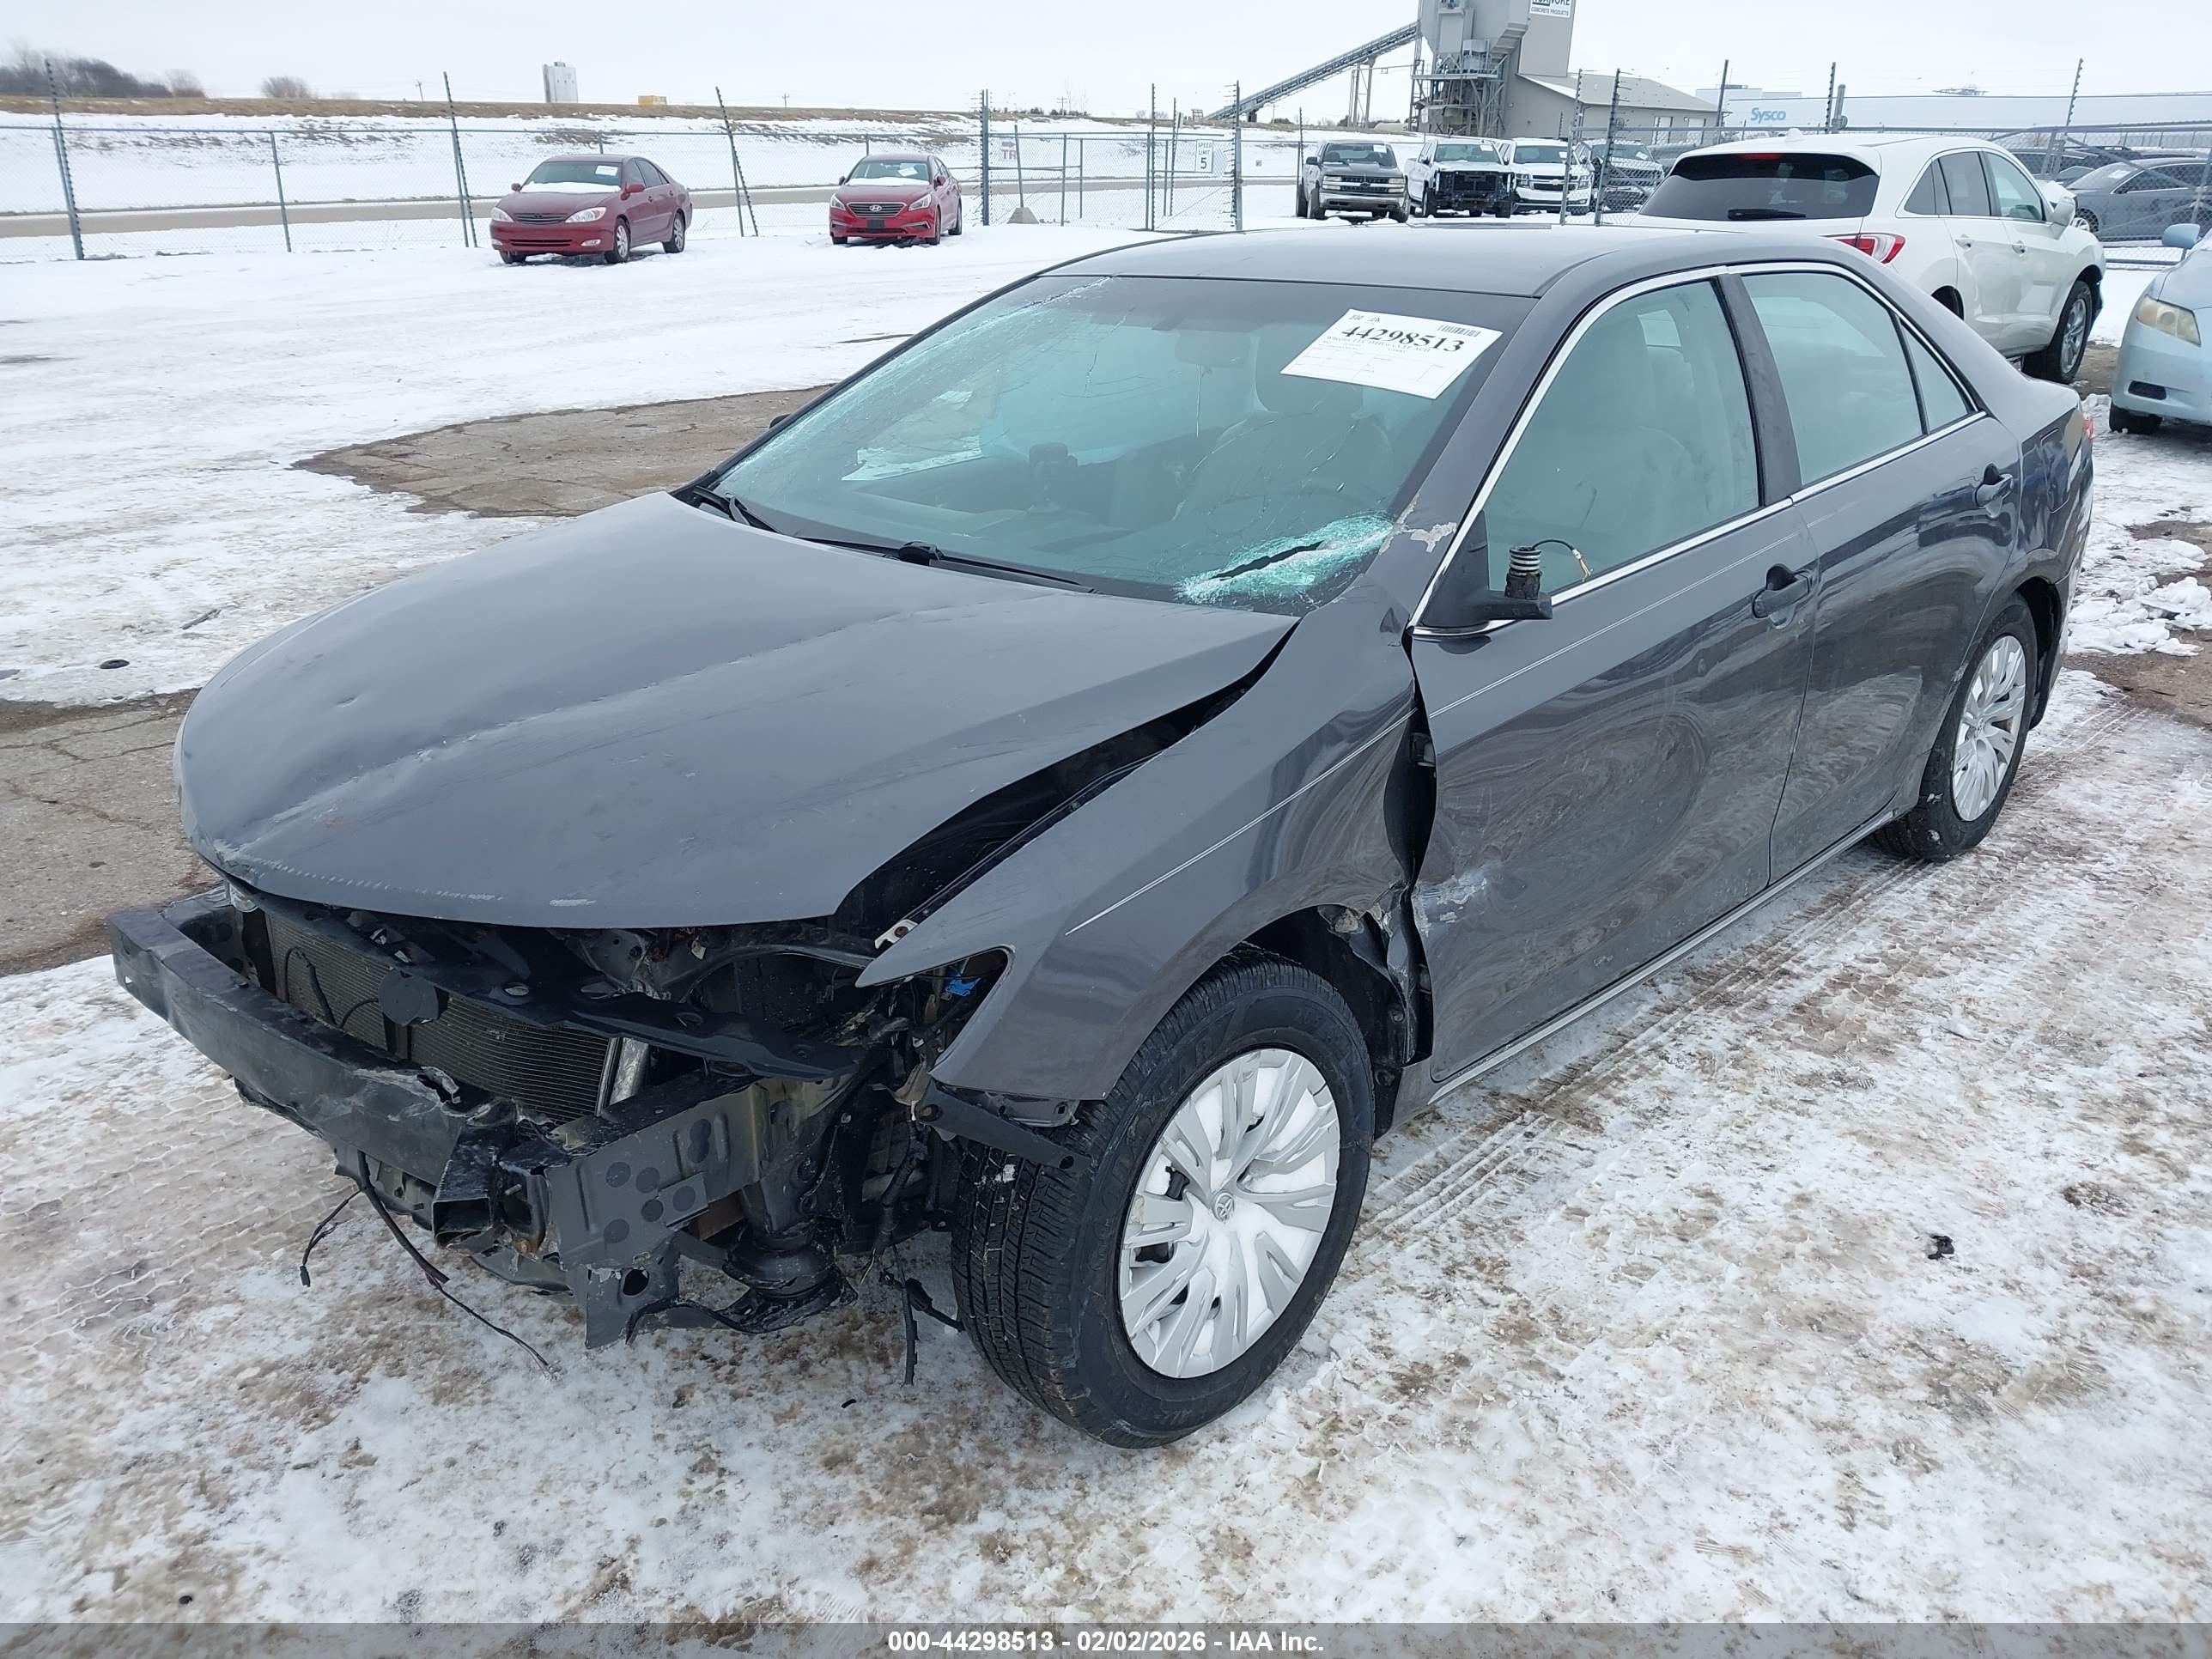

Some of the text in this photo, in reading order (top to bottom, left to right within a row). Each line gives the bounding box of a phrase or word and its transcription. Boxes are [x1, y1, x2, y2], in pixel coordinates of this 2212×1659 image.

[1751, 106, 1787, 125] Sysco
[1200, 157, 1207, 170] 5
[1341, 325, 1465, 353] 44298513
